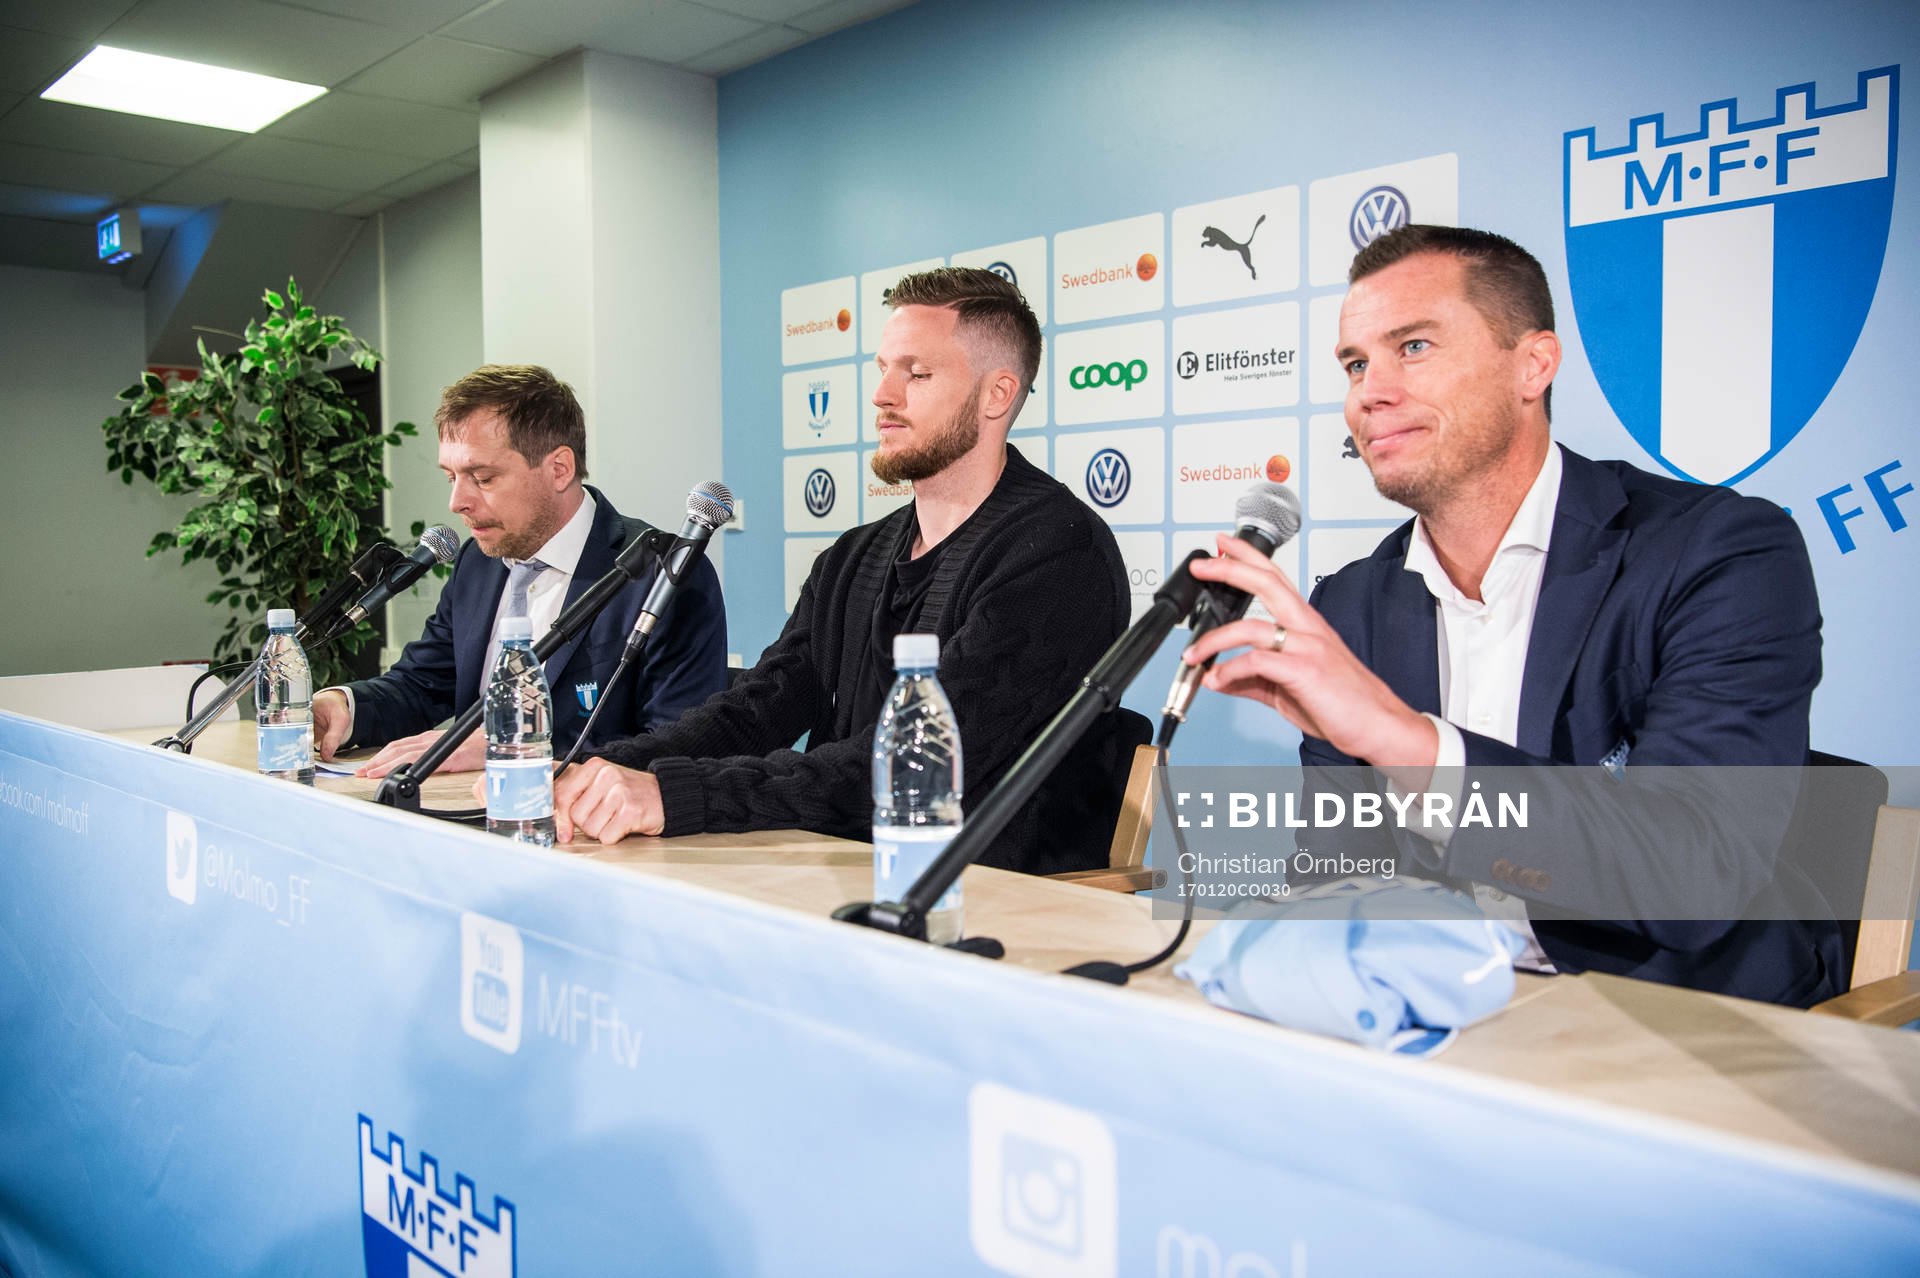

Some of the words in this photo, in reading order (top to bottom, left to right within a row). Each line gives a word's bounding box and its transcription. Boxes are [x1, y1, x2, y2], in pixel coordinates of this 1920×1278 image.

[1061, 263, 1133, 289] Swedbank
[786, 317, 834, 337] Swedbank
[1206, 347, 1295, 372] Elitfönster
[1069, 358, 1148, 391] coop
[1180, 462, 1262, 482] Swedbank
[1816, 459, 1914, 555] FF
[536, 972, 644, 1071] MFFtv
